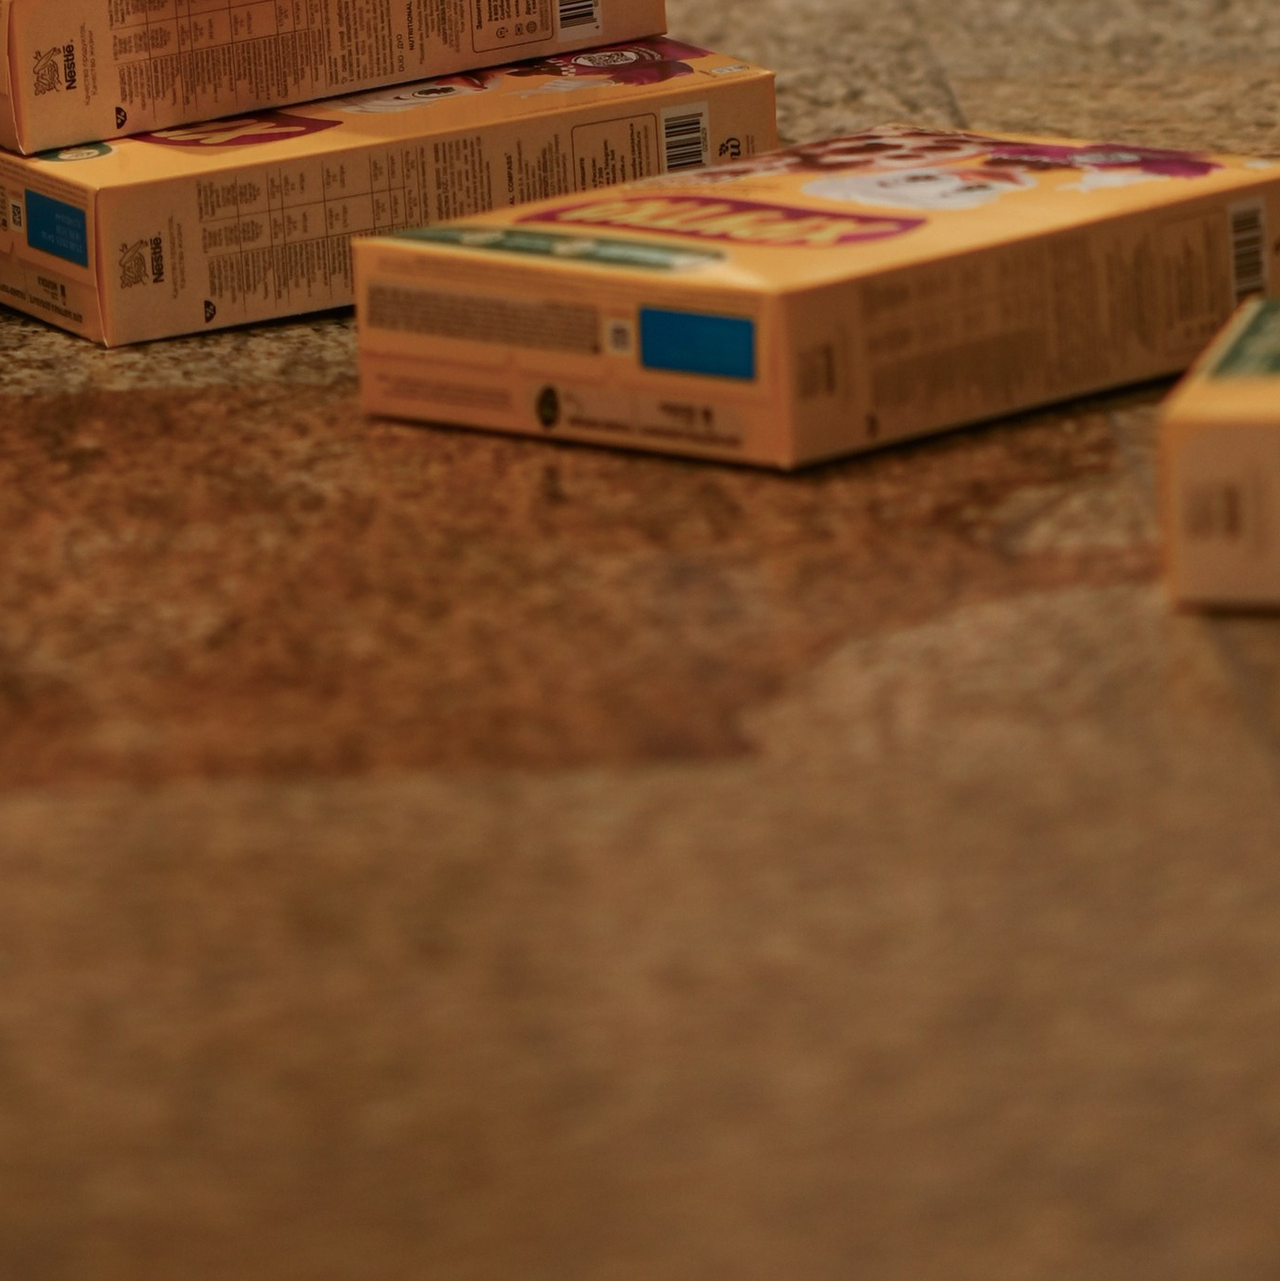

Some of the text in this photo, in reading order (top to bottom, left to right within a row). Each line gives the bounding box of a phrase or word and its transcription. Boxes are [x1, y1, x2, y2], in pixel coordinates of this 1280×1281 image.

[405, 0, 414, 51] NUTRITIONAL
[62, 43, 77, 90] Nestlé
[82, 68, 91, 106] Качество
[89, 58, 97, 95] Качество
[149, 235, 164, 284] Nestlé
